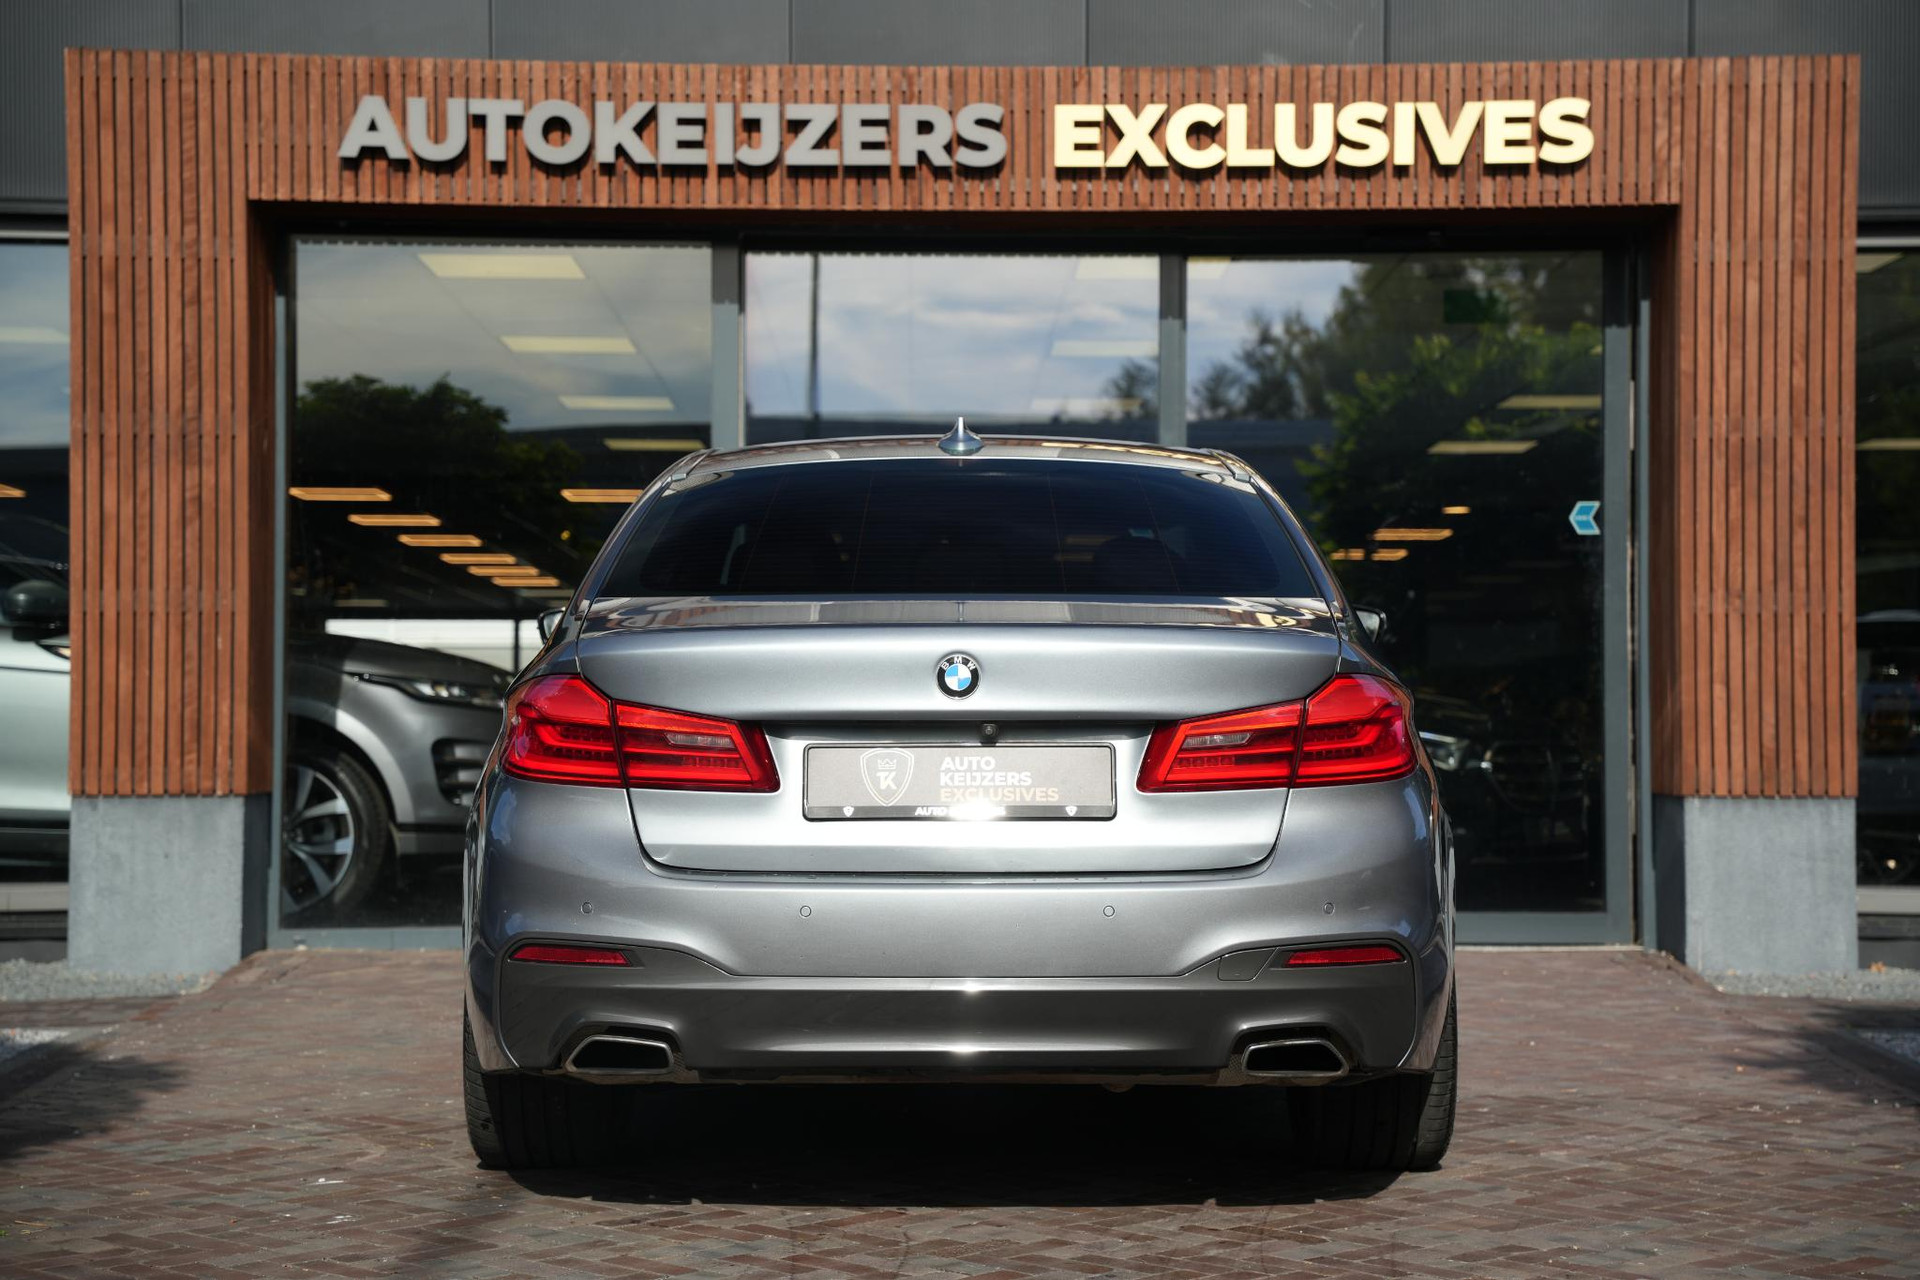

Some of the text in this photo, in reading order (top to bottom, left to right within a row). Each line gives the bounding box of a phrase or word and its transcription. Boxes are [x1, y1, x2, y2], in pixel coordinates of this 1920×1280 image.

[338, 95, 1595, 169] AUTOKEIJZERS EXCLUSIVES
[940, 655, 976, 671] BMW
[940, 756, 996, 771] AUTO
[940, 771, 1032, 786] KEIJZERS
[940, 787, 1060, 802] EXCLUSIVES
